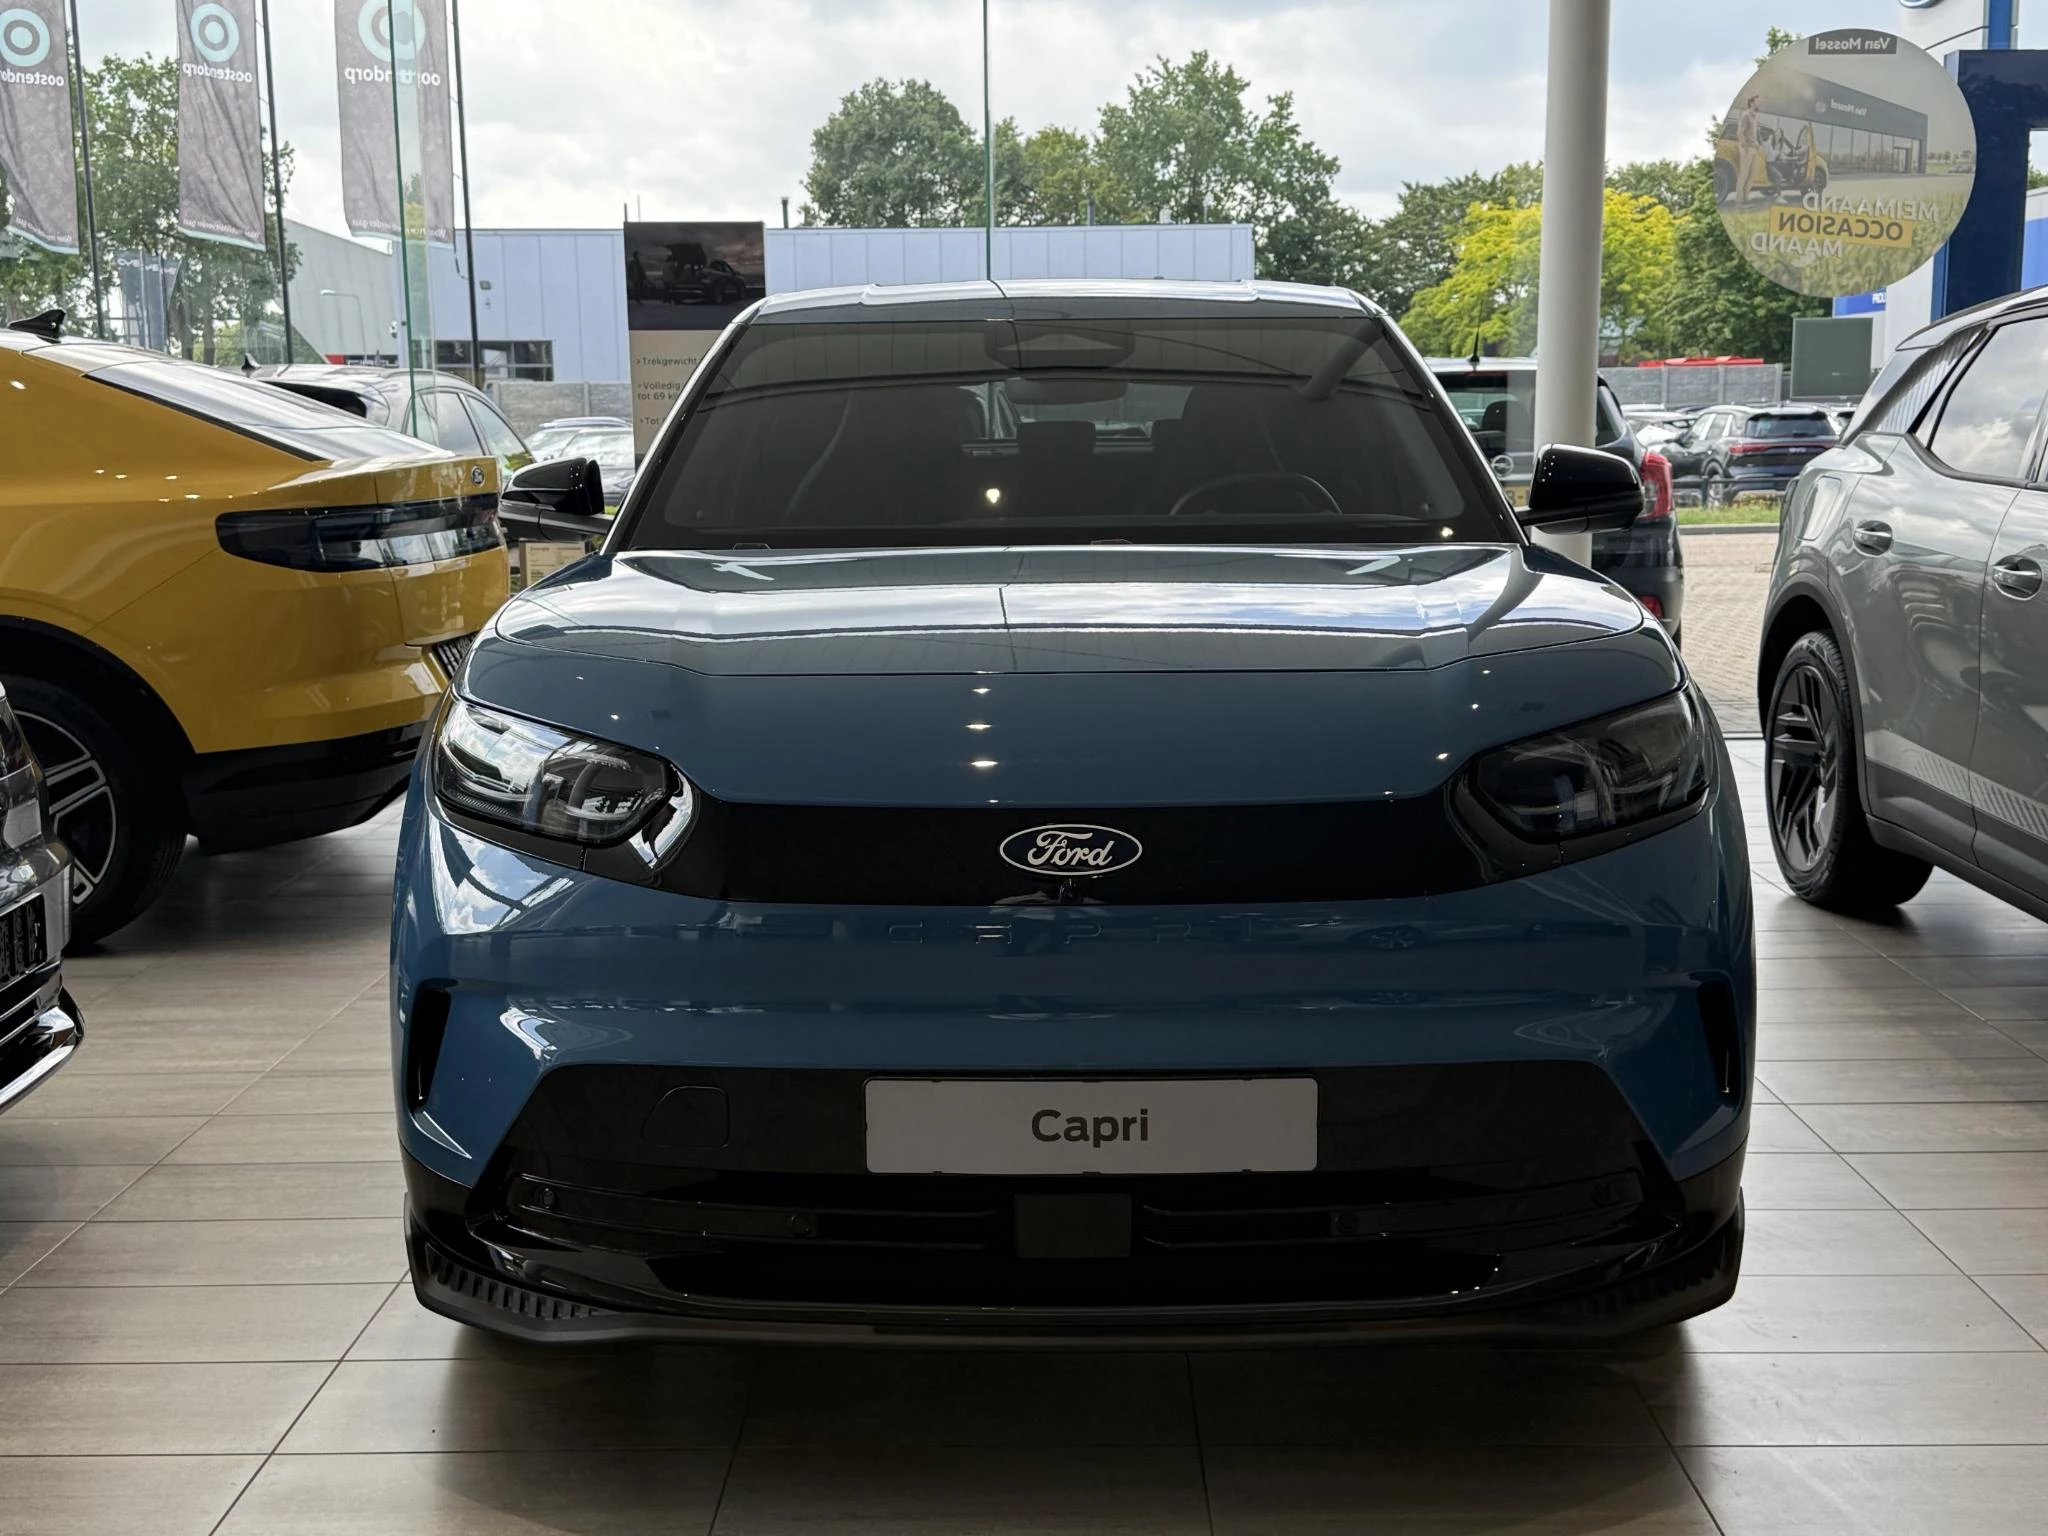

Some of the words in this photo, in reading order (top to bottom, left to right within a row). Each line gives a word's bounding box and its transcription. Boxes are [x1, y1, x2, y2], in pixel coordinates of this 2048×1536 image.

[642, 357, 697, 367] Trekgewicht
[637, 392, 650, 400] tot
[644, 416, 659, 425] Tot
[1027, 830, 1115, 866] Ford
[1031, 1108, 1149, 1149] Capri
